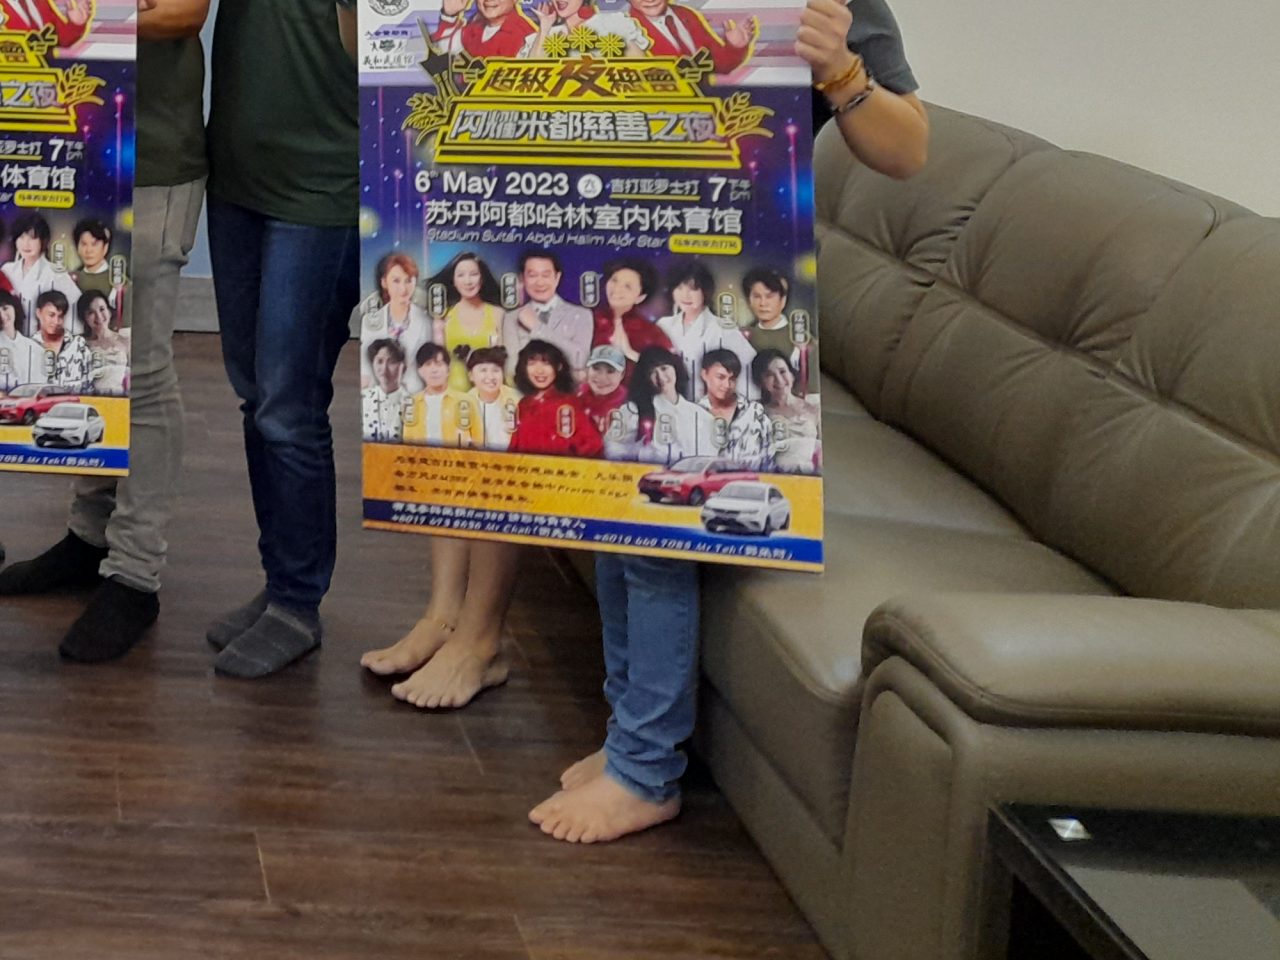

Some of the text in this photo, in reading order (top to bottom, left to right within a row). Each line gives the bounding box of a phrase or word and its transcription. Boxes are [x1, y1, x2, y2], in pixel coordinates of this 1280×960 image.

[450, 109, 719, 142] 闪耀米都慈善之夜
[48, 138, 65, 162] 7
[442, 171, 498, 200] May
[505, 171, 569, 196] 2023
[708, 176, 727, 202] 7
[425, 199, 743, 235] 苏丹阿都哈林室内体育馆
[427, 227, 480, 242] Stadium
[481, 228, 523, 243] Sultan
[566, 233, 604, 246] Halim
[606, 233, 636, 247] Alor
[637, 234, 667, 248] Star
